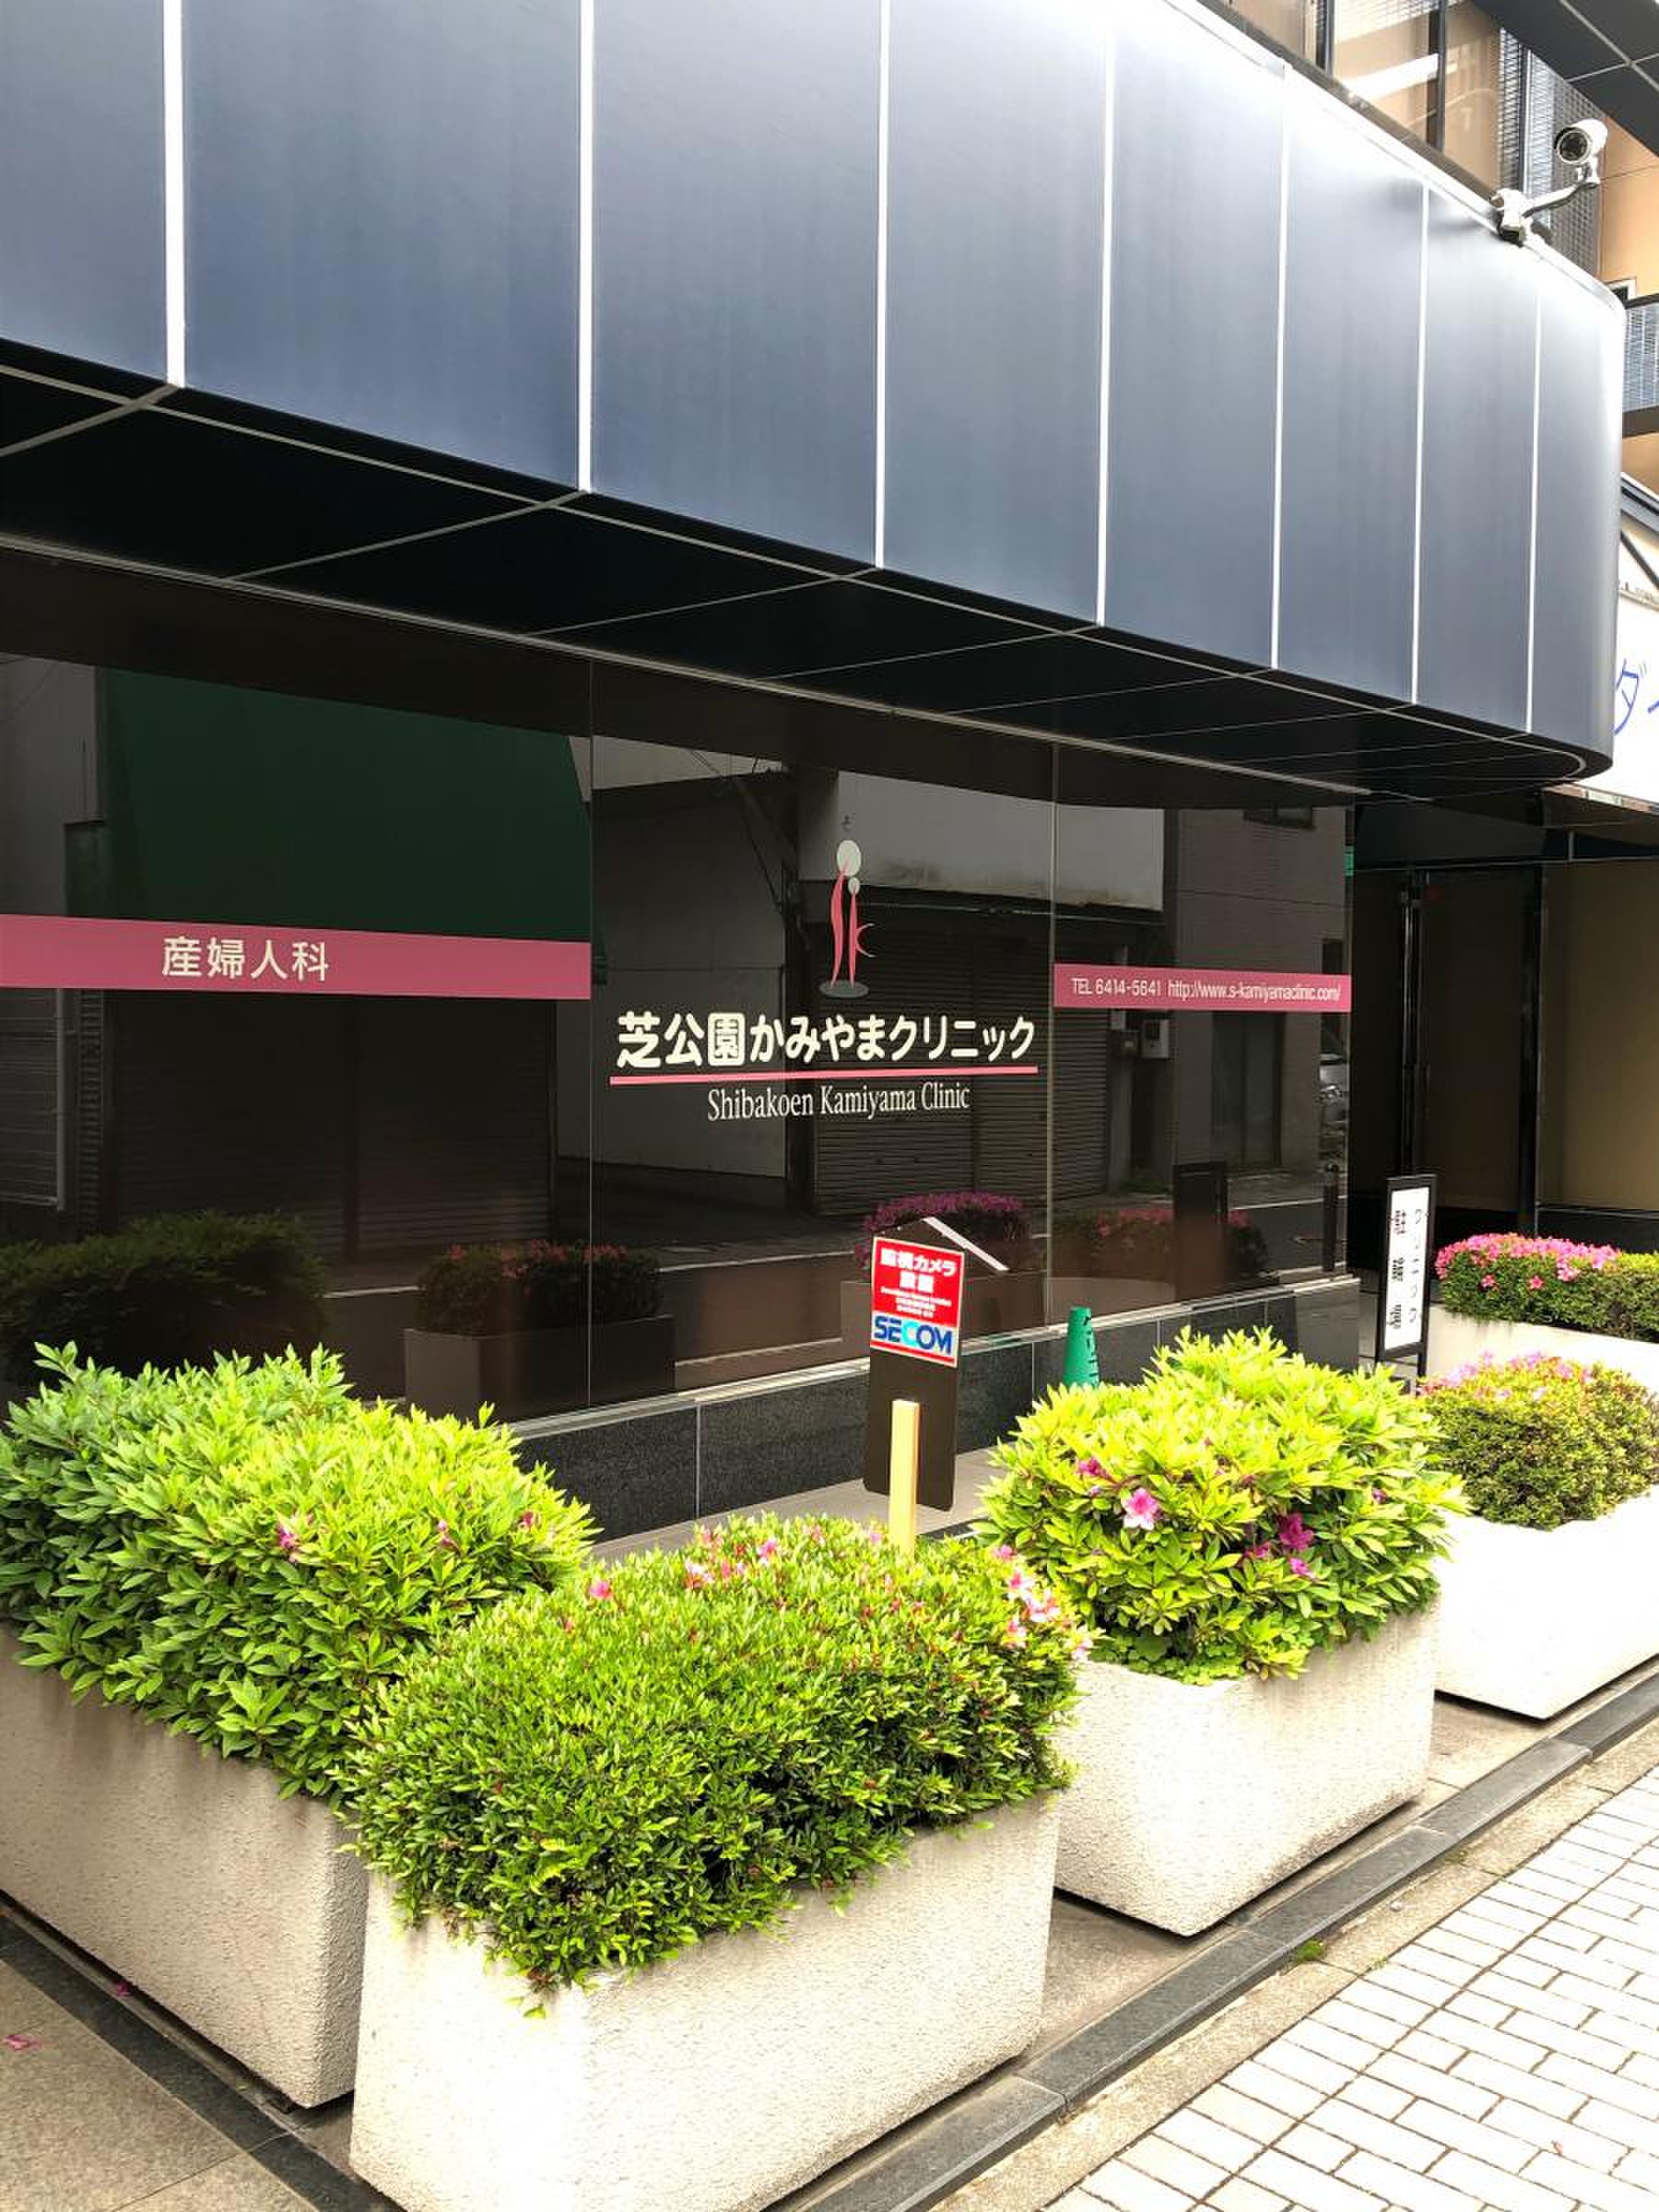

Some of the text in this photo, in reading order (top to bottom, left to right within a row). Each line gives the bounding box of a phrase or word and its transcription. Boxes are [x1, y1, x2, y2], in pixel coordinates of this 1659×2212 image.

[1614, 657, 1659, 735] ダ
[162, 935, 329, 982] 産婦人科
[1072, 978, 1093, 995] TEL
[617, 1010, 1035, 1068] 芝公園かみやまクリニック
[707, 1081, 971, 1122] Shibakoen Kamiyama Clinic
[875, 1315, 953, 1355] SECOM
